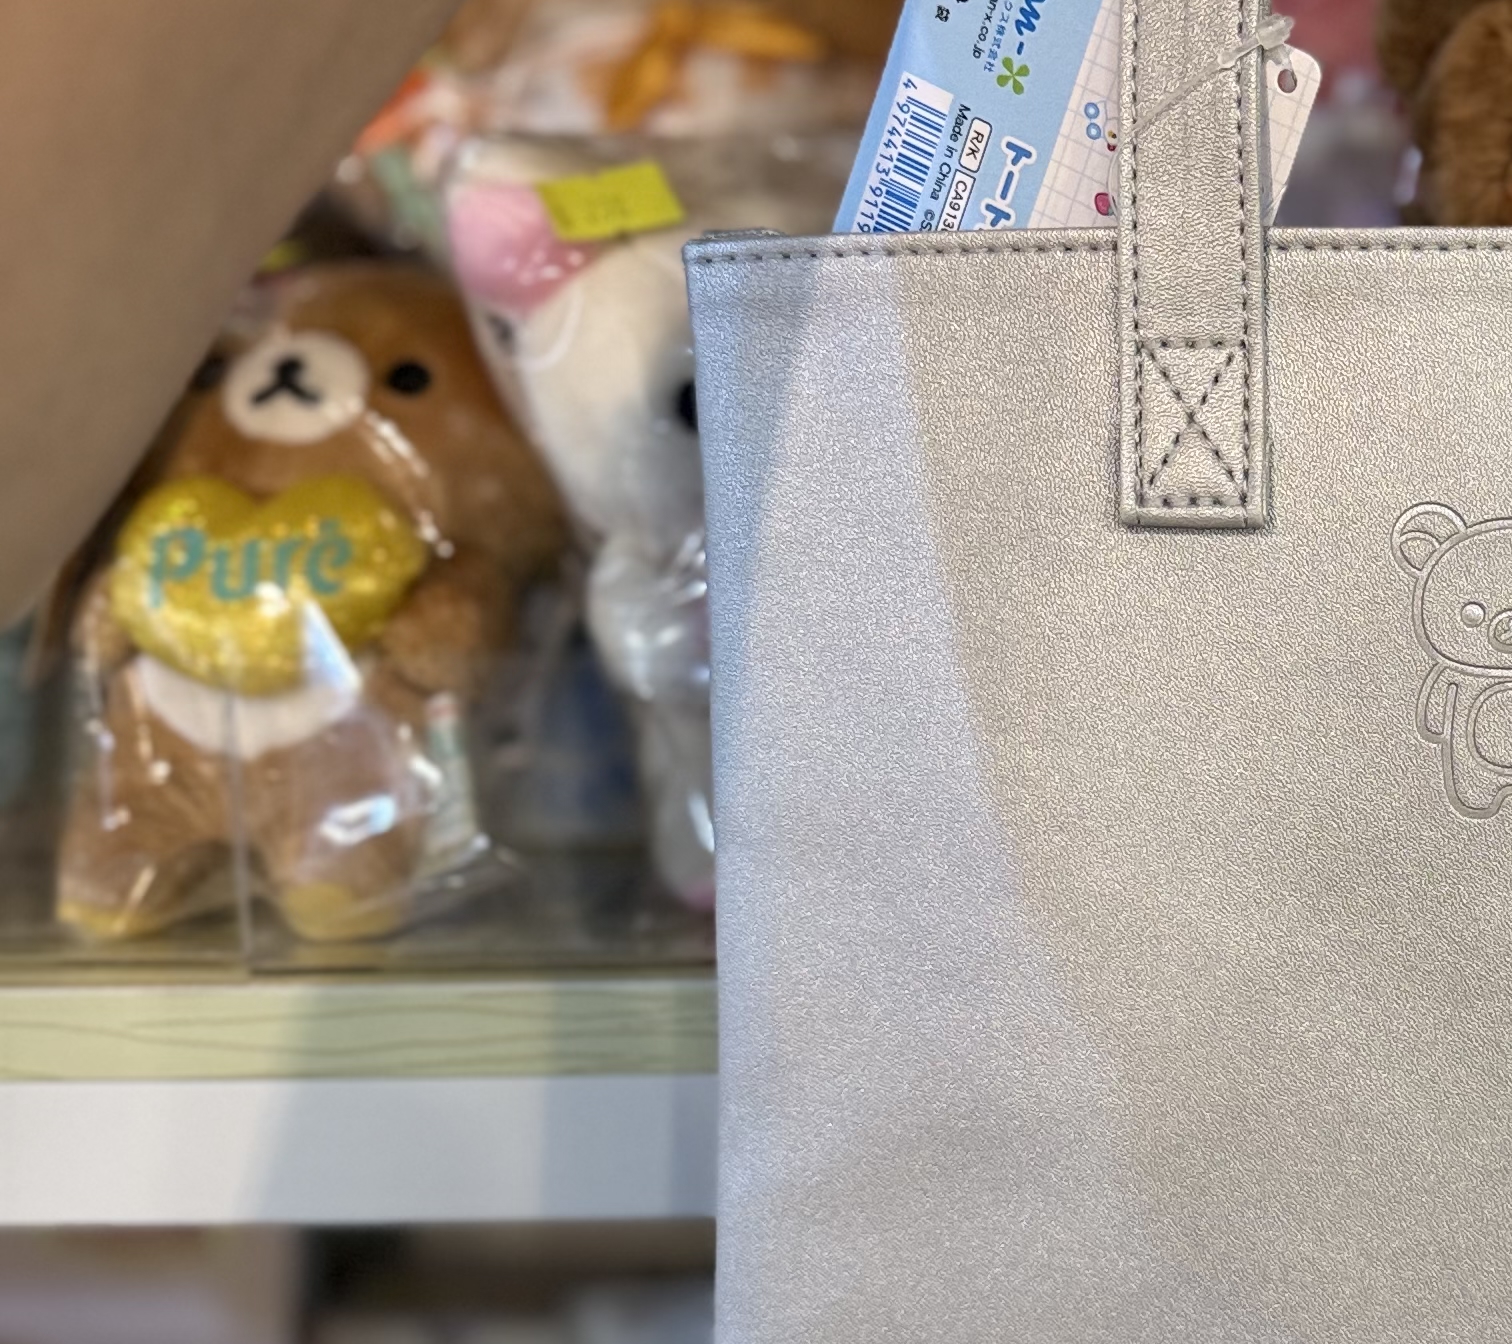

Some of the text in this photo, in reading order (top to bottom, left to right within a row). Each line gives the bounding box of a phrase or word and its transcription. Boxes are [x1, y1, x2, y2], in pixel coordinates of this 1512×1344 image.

[949, 104, 972, 143] Made
[944, 145, 958, 159] in
[965, 129, 985, 161] R/K
[930, 162, 951, 201] China
[978, 141, 1033, 231] トート
